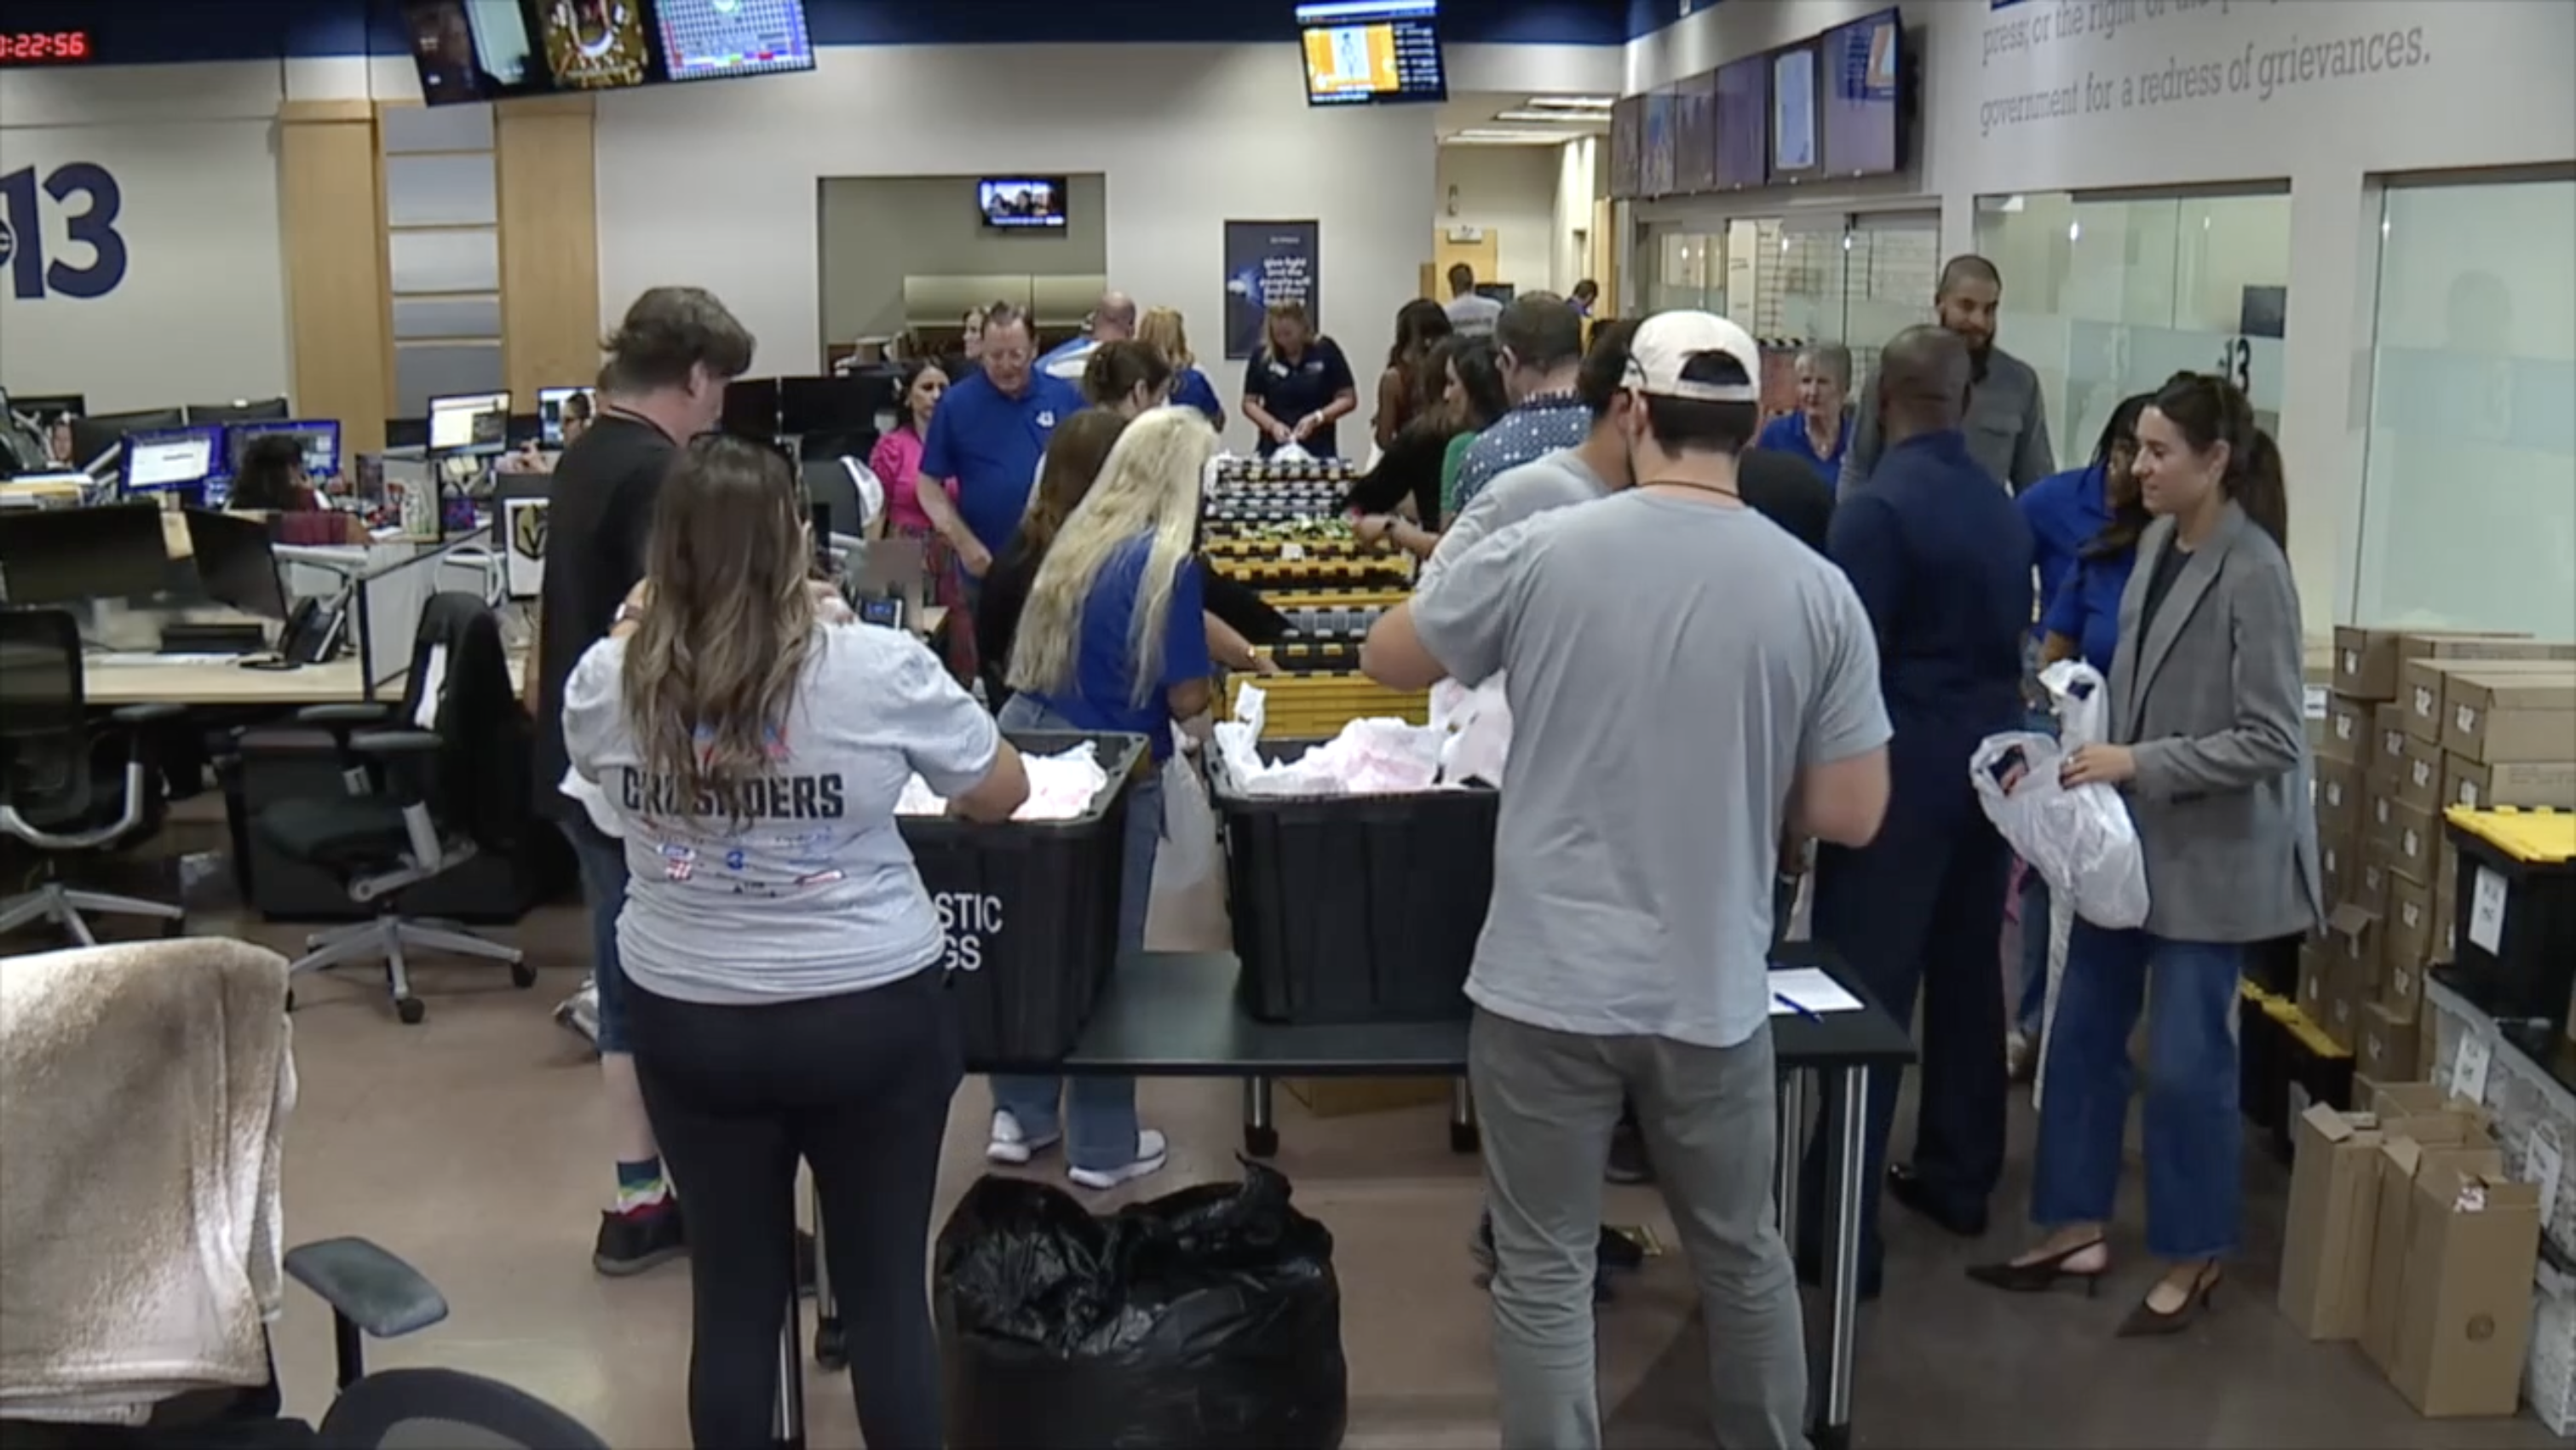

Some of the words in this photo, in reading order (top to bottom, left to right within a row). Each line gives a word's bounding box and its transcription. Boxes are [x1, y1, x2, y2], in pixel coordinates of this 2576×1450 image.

[2032, 13, 2052, 43] or
[2056, 0, 2084, 39] the
[1980, 79, 2078, 136] government
[2085, 72, 2113, 113] for
[2121, 76, 2133, 107] a
[2138, 55, 2222, 106] redress
[2227, 41, 2255, 93] of
[2258, 26, 2430, 101] grievances.
[0, 161, 127, 299] 13
